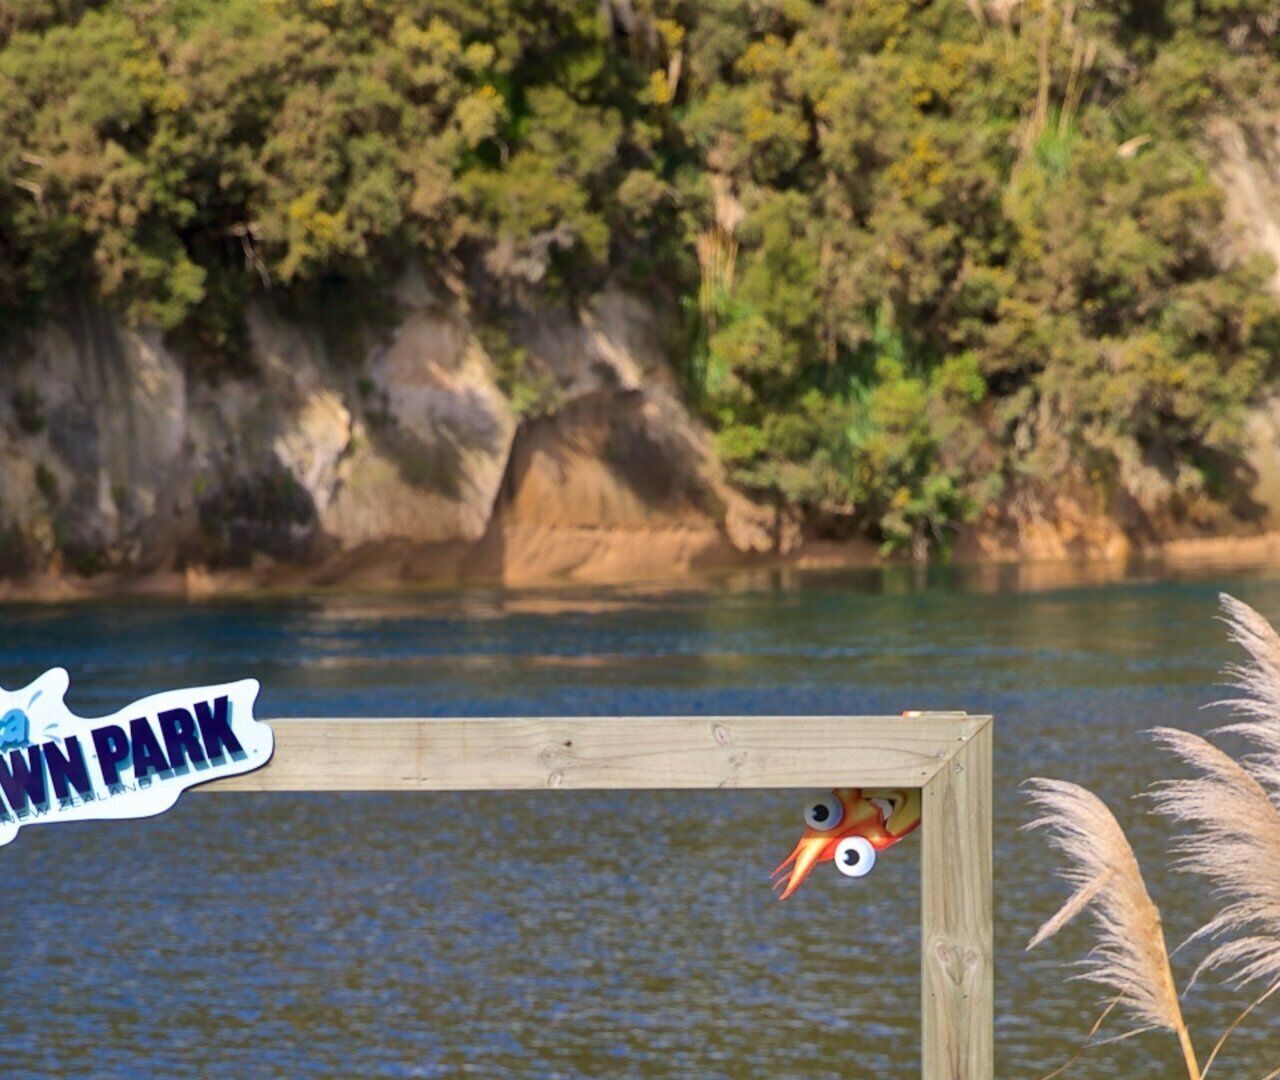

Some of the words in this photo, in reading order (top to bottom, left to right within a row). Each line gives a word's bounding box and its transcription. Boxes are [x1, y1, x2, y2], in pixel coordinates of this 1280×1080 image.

[91, 695, 247, 789] PARK
[1, 807, 49, 825] NEW
[58, 777, 152, 811] ZEALAND
